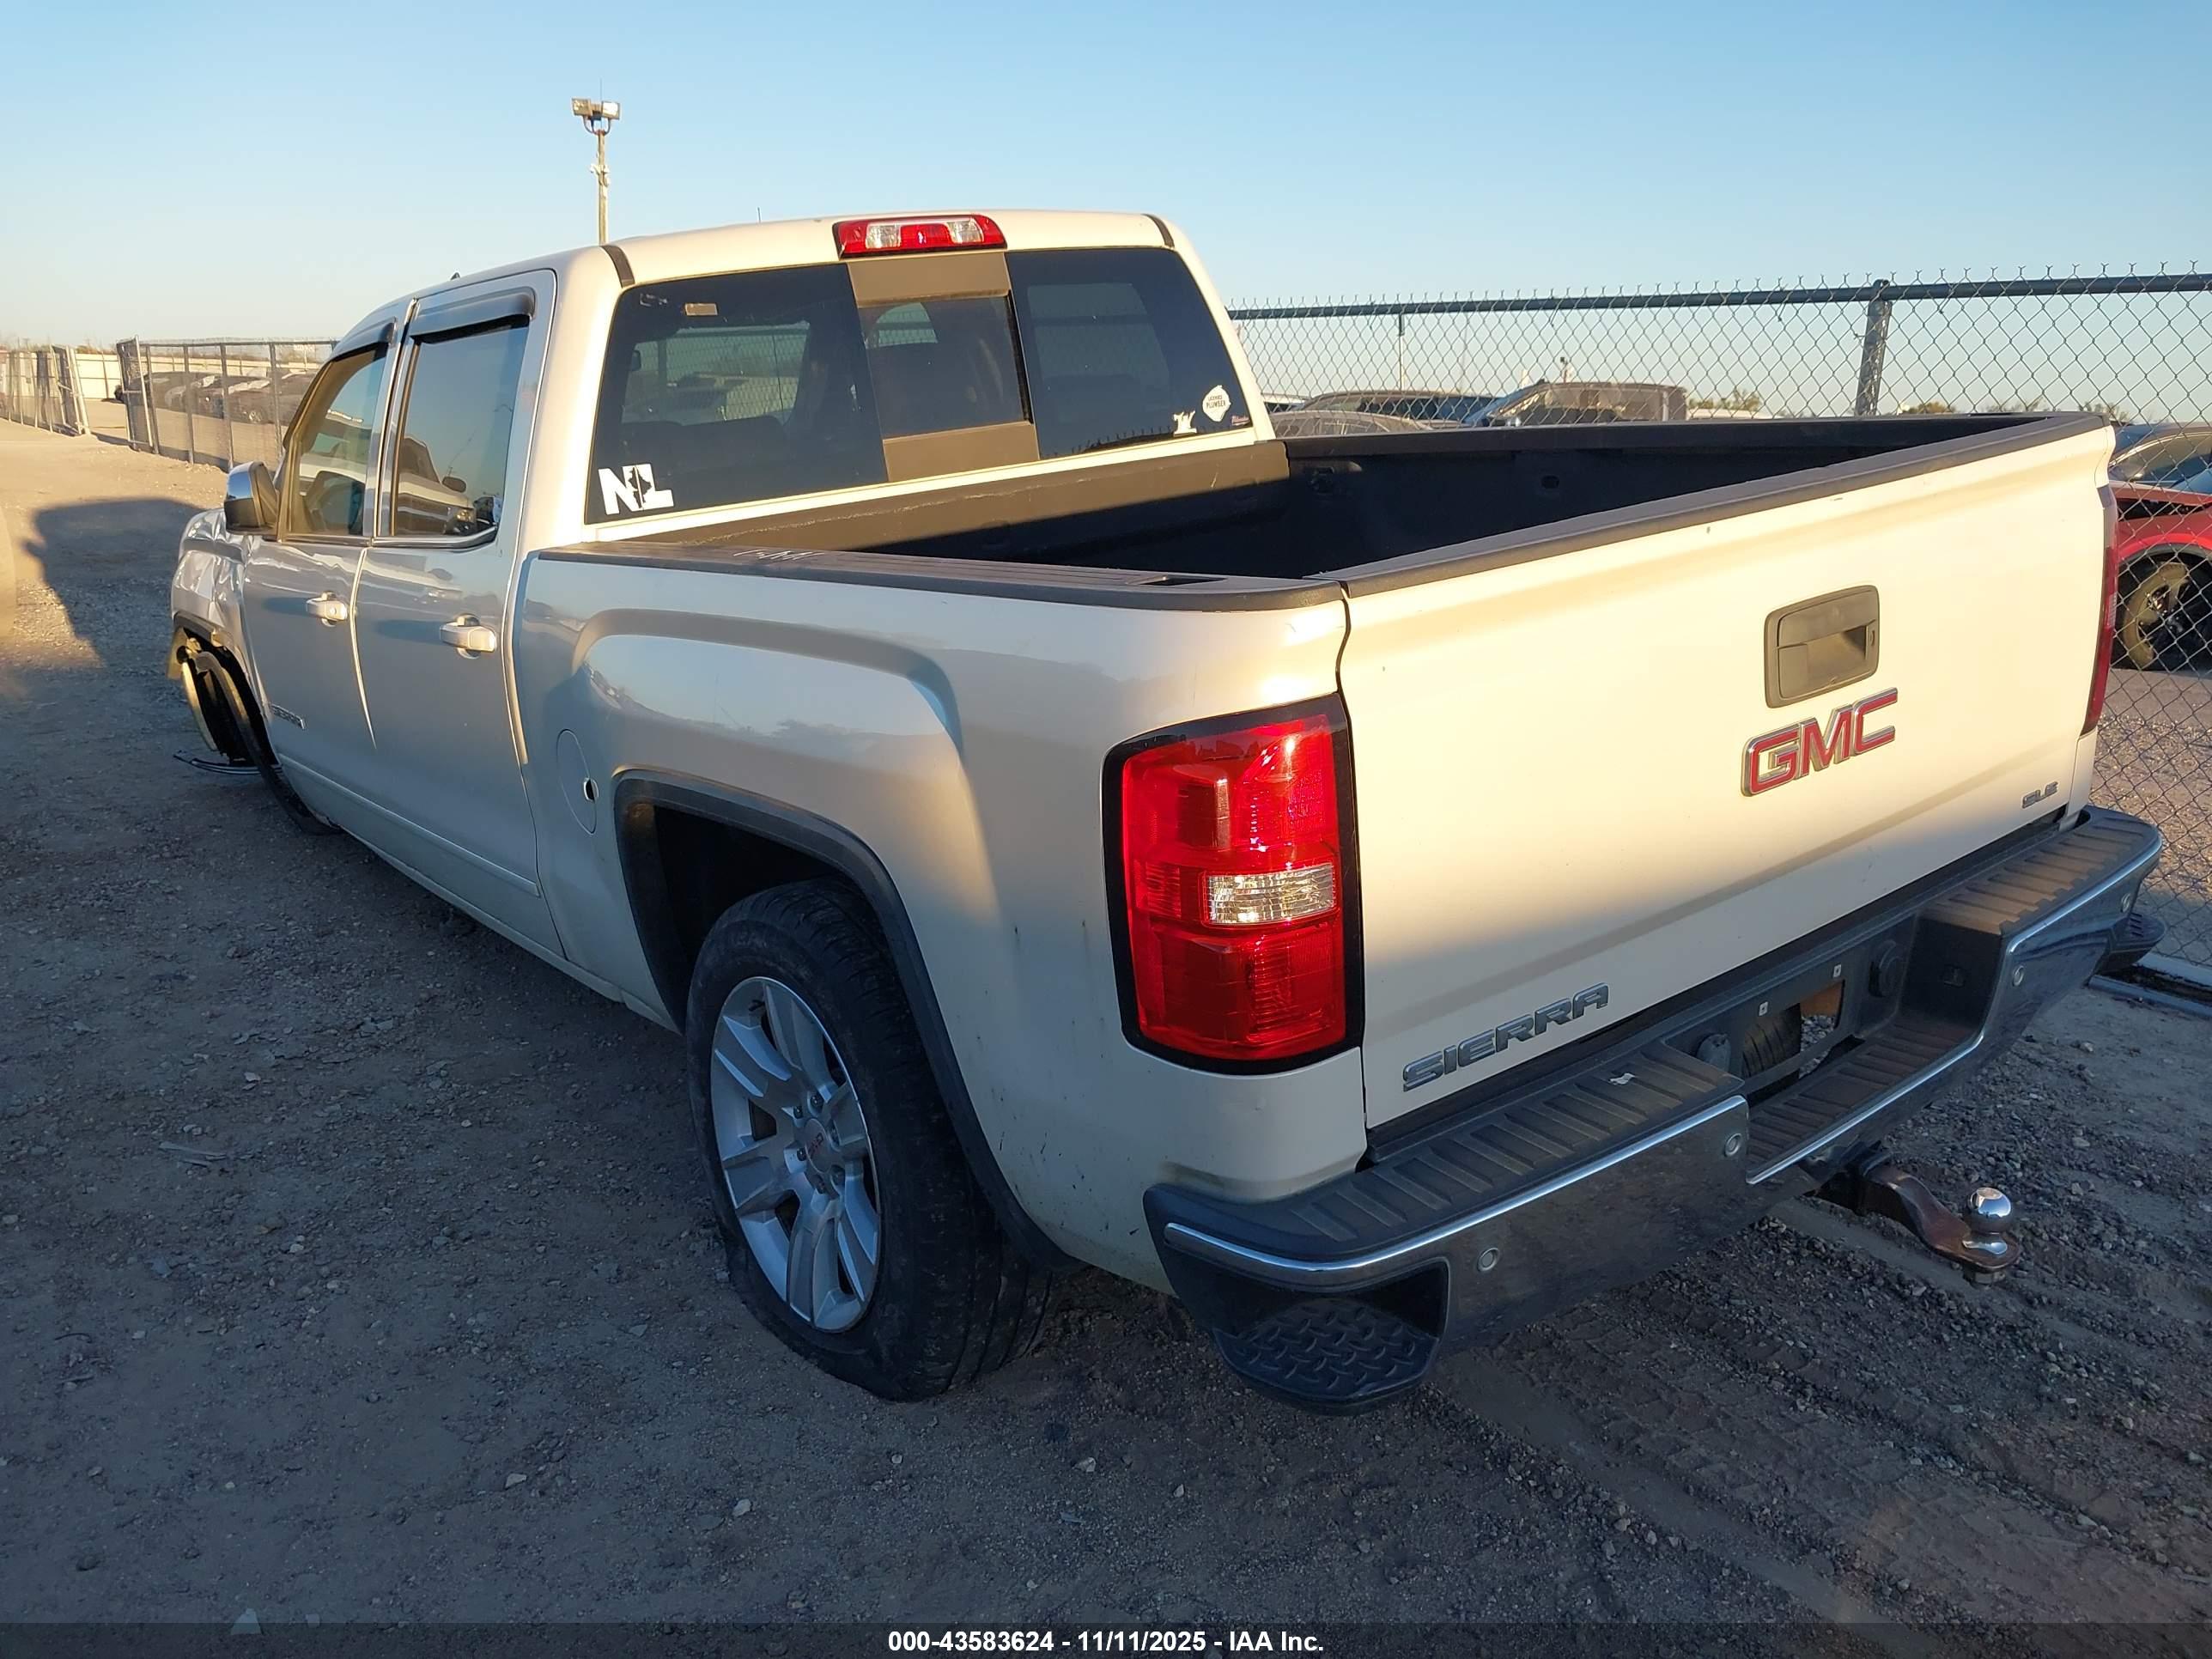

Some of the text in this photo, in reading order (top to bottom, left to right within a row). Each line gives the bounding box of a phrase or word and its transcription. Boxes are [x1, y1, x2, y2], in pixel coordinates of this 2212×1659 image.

[599, 463, 674, 515] NL
[1741, 687, 1898, 797] GMC
[1402, 982, 1609, 1092] SIERRA
